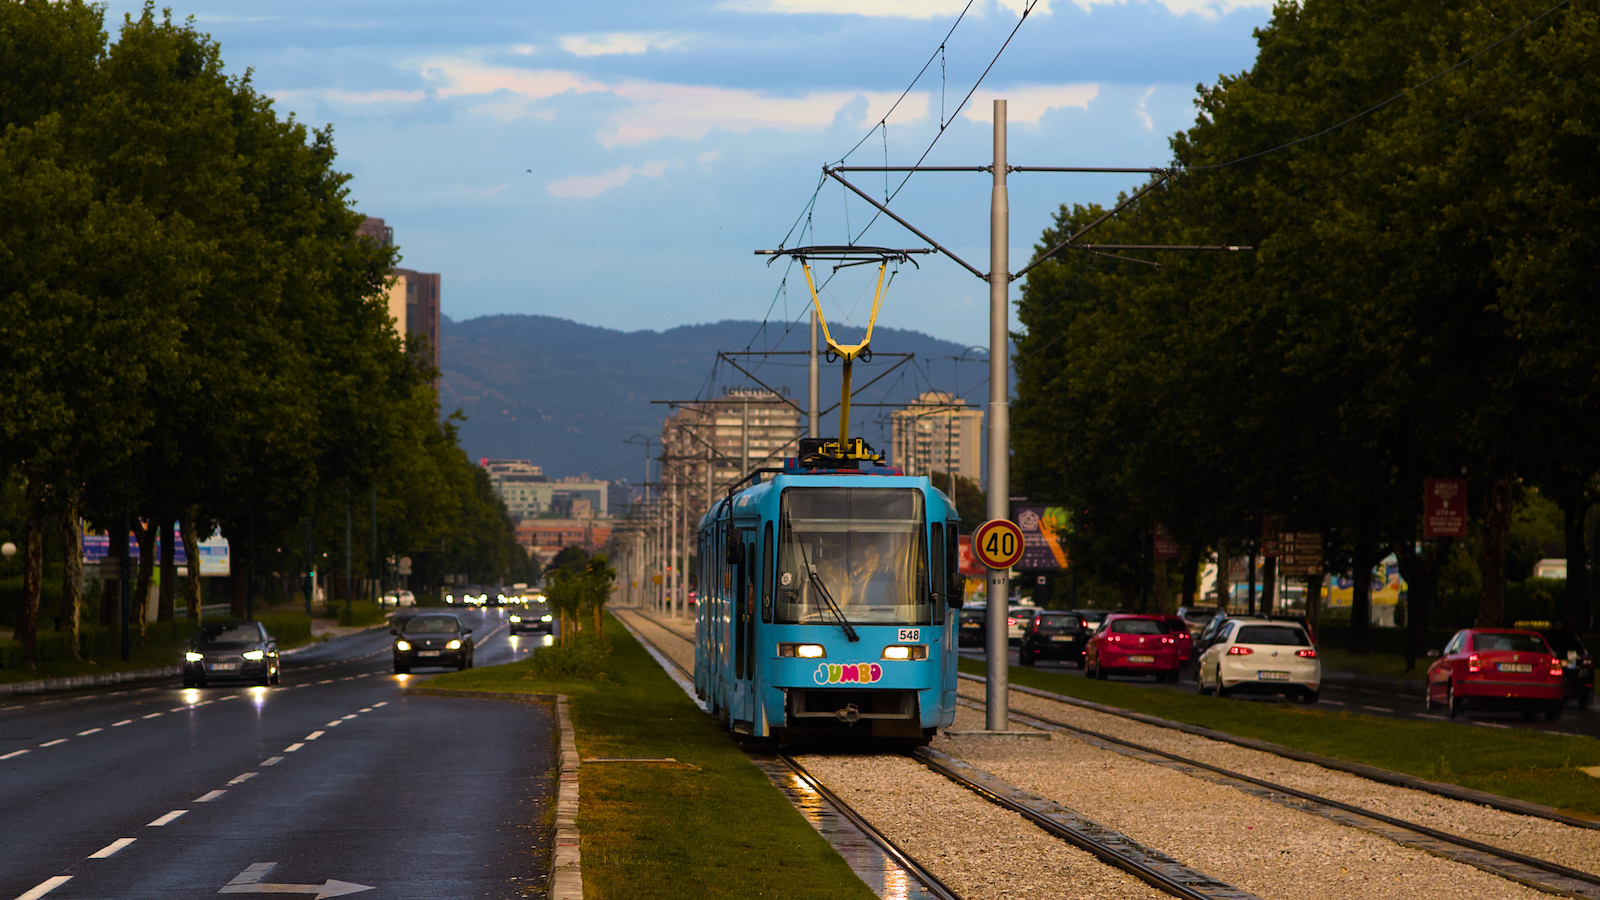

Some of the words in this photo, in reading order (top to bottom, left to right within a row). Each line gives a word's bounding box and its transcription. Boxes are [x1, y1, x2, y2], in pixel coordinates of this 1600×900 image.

[722, 384, 791, 396] telemach
[986, 532, 1014, 556] 40
[899, 630, 920, 640] 548
[813, 662, 883, 685] JUMBO
